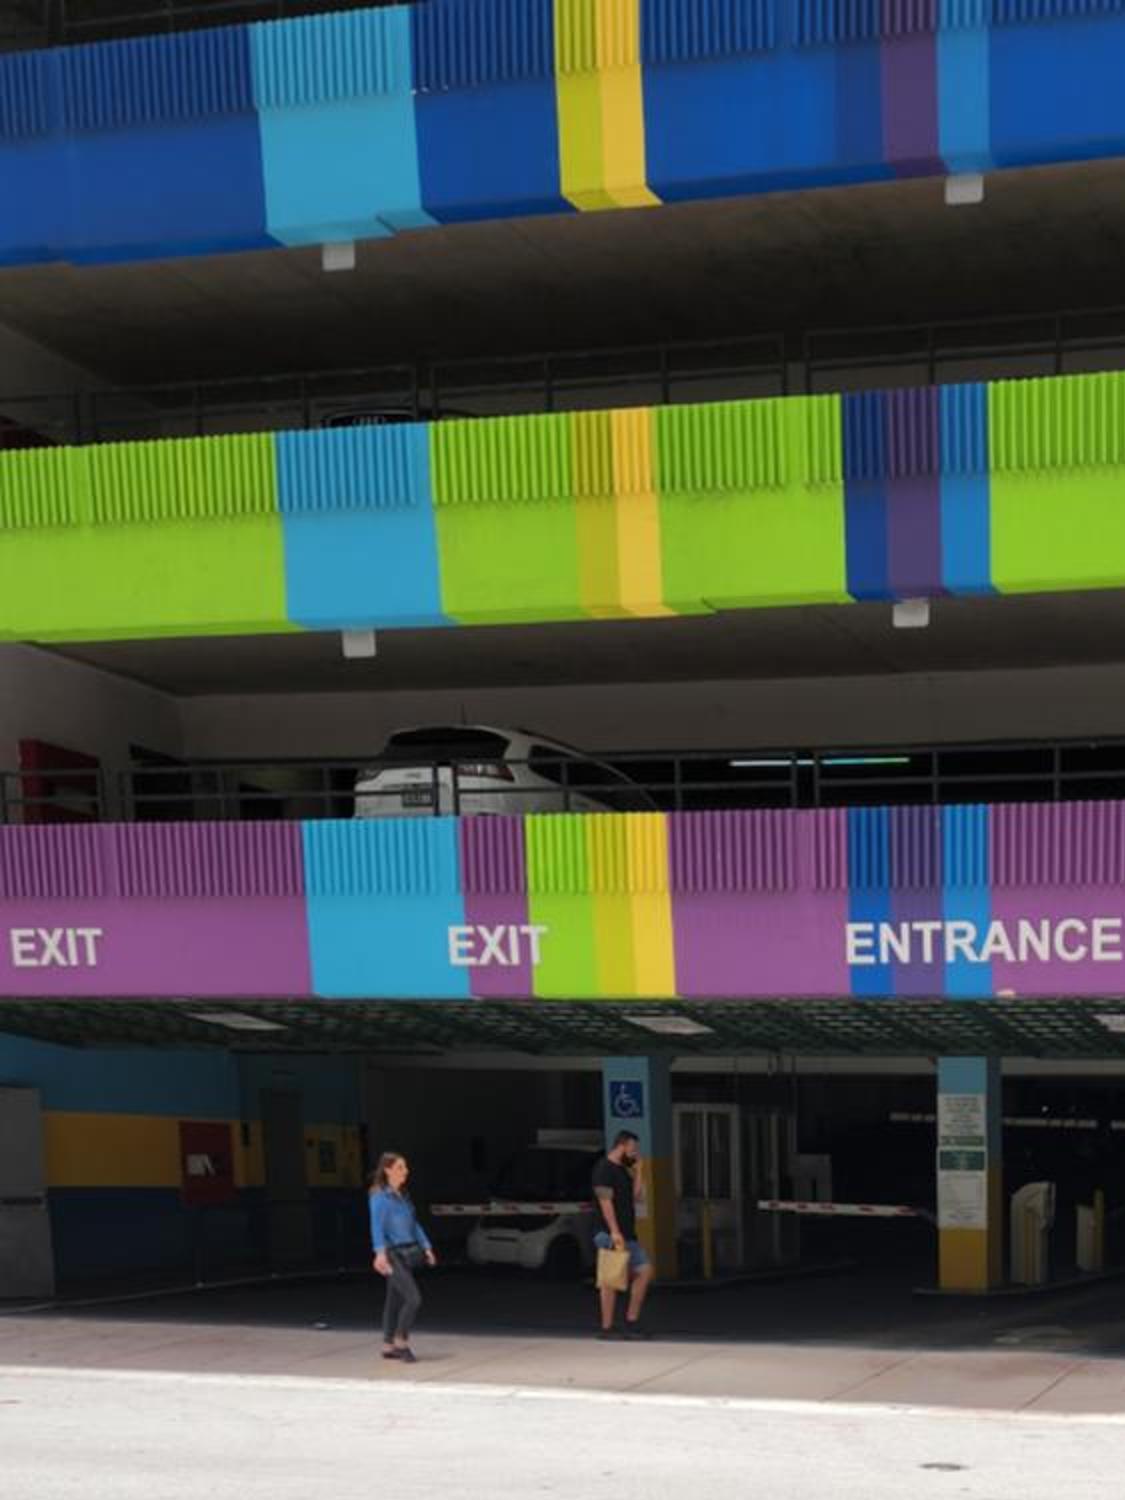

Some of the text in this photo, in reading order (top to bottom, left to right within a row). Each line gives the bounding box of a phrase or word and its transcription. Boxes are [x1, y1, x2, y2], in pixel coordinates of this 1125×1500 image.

[10, 928, 102, 966] EXIT
[448, 926, 549, 965] EXIT
[846, 918, 1123, 964] ENTRANCE
